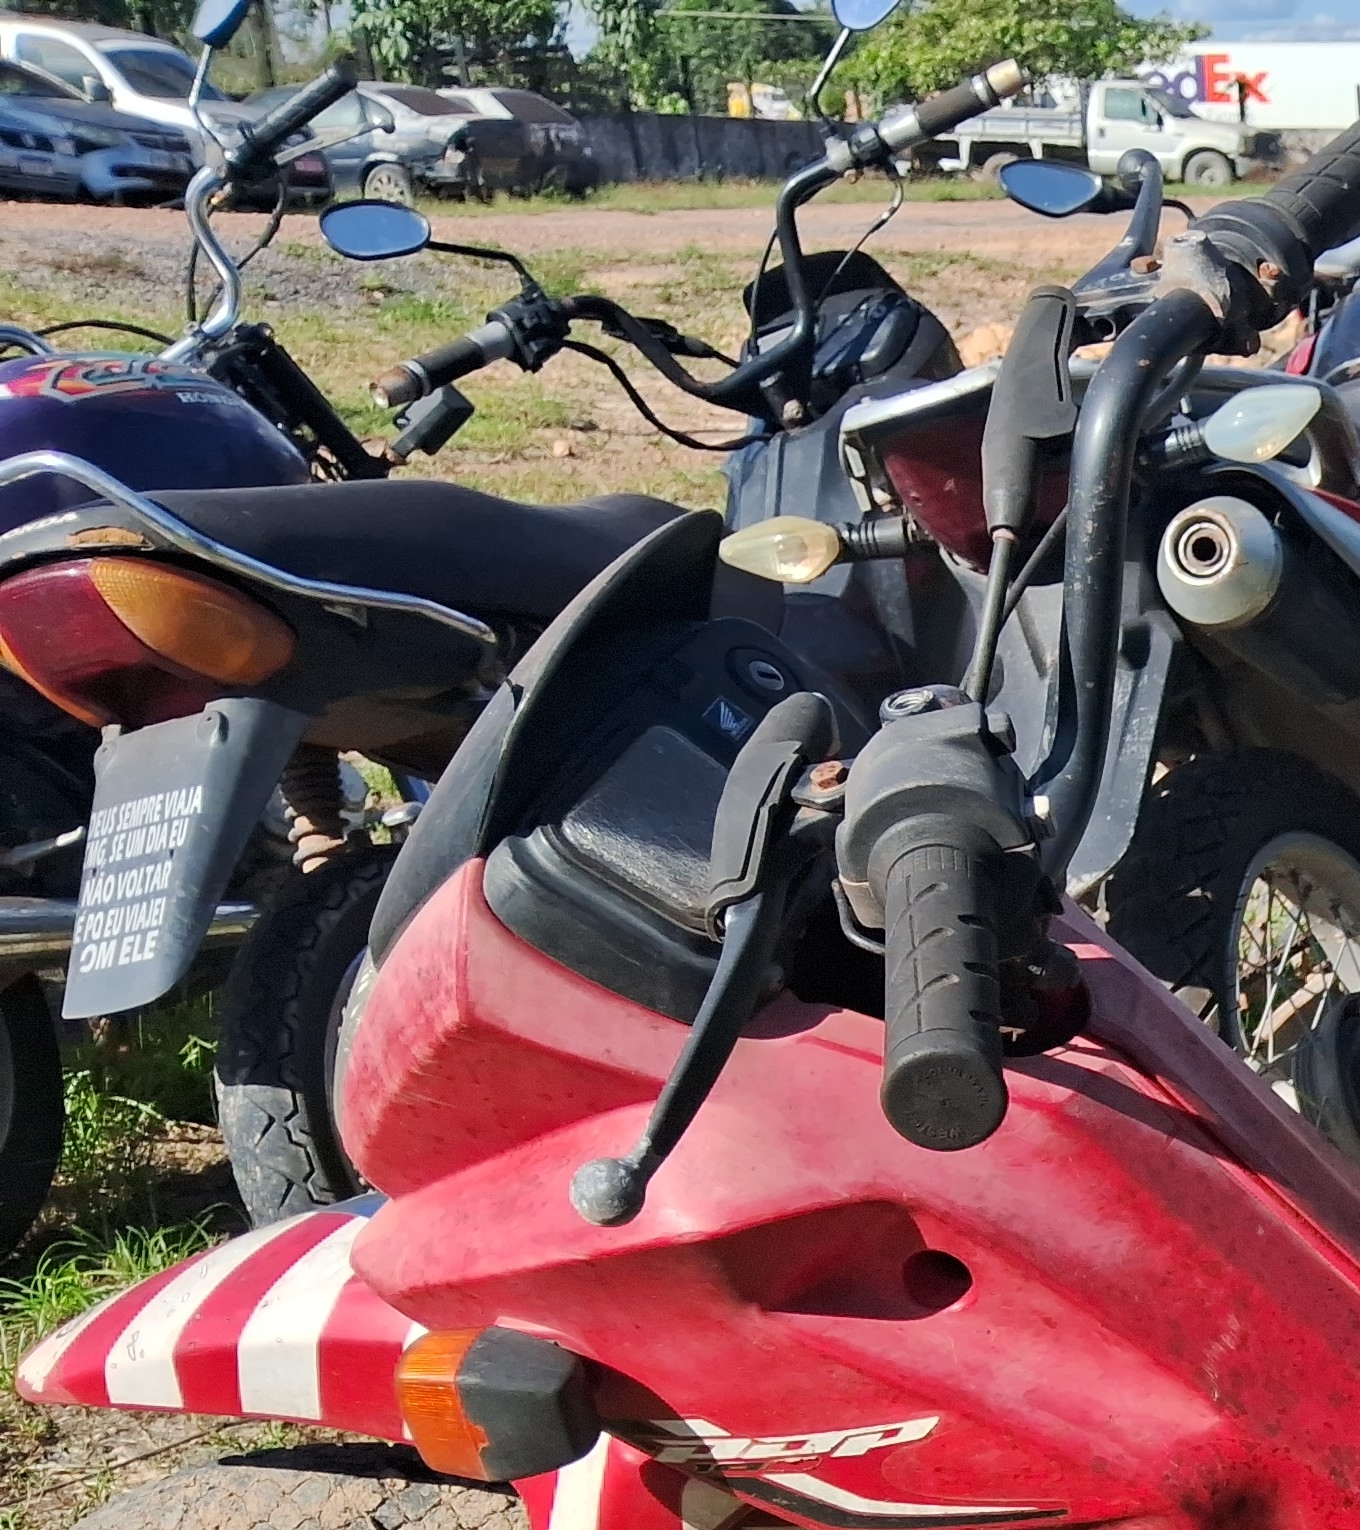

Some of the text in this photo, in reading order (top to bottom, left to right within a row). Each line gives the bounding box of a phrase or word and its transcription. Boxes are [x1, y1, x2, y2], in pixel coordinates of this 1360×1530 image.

[1142, 54, 1270, 102] edEx
[117, 794, 165, 832] SEMPRE
[164, 785, 203, 817] VIAJA
[109, 834, 125, 864] SE
[125, 827, 147, 860] UM
[146, 822, 167, 854] DIA
[169, 817, 190, 849] EU
[80, 861, 173, 908] NÃO VOLTAR
[103, 905, 125, 938] EU
[124, 896, 167, 933] VIAJEI
[118, 929, 160, 966] ELE
